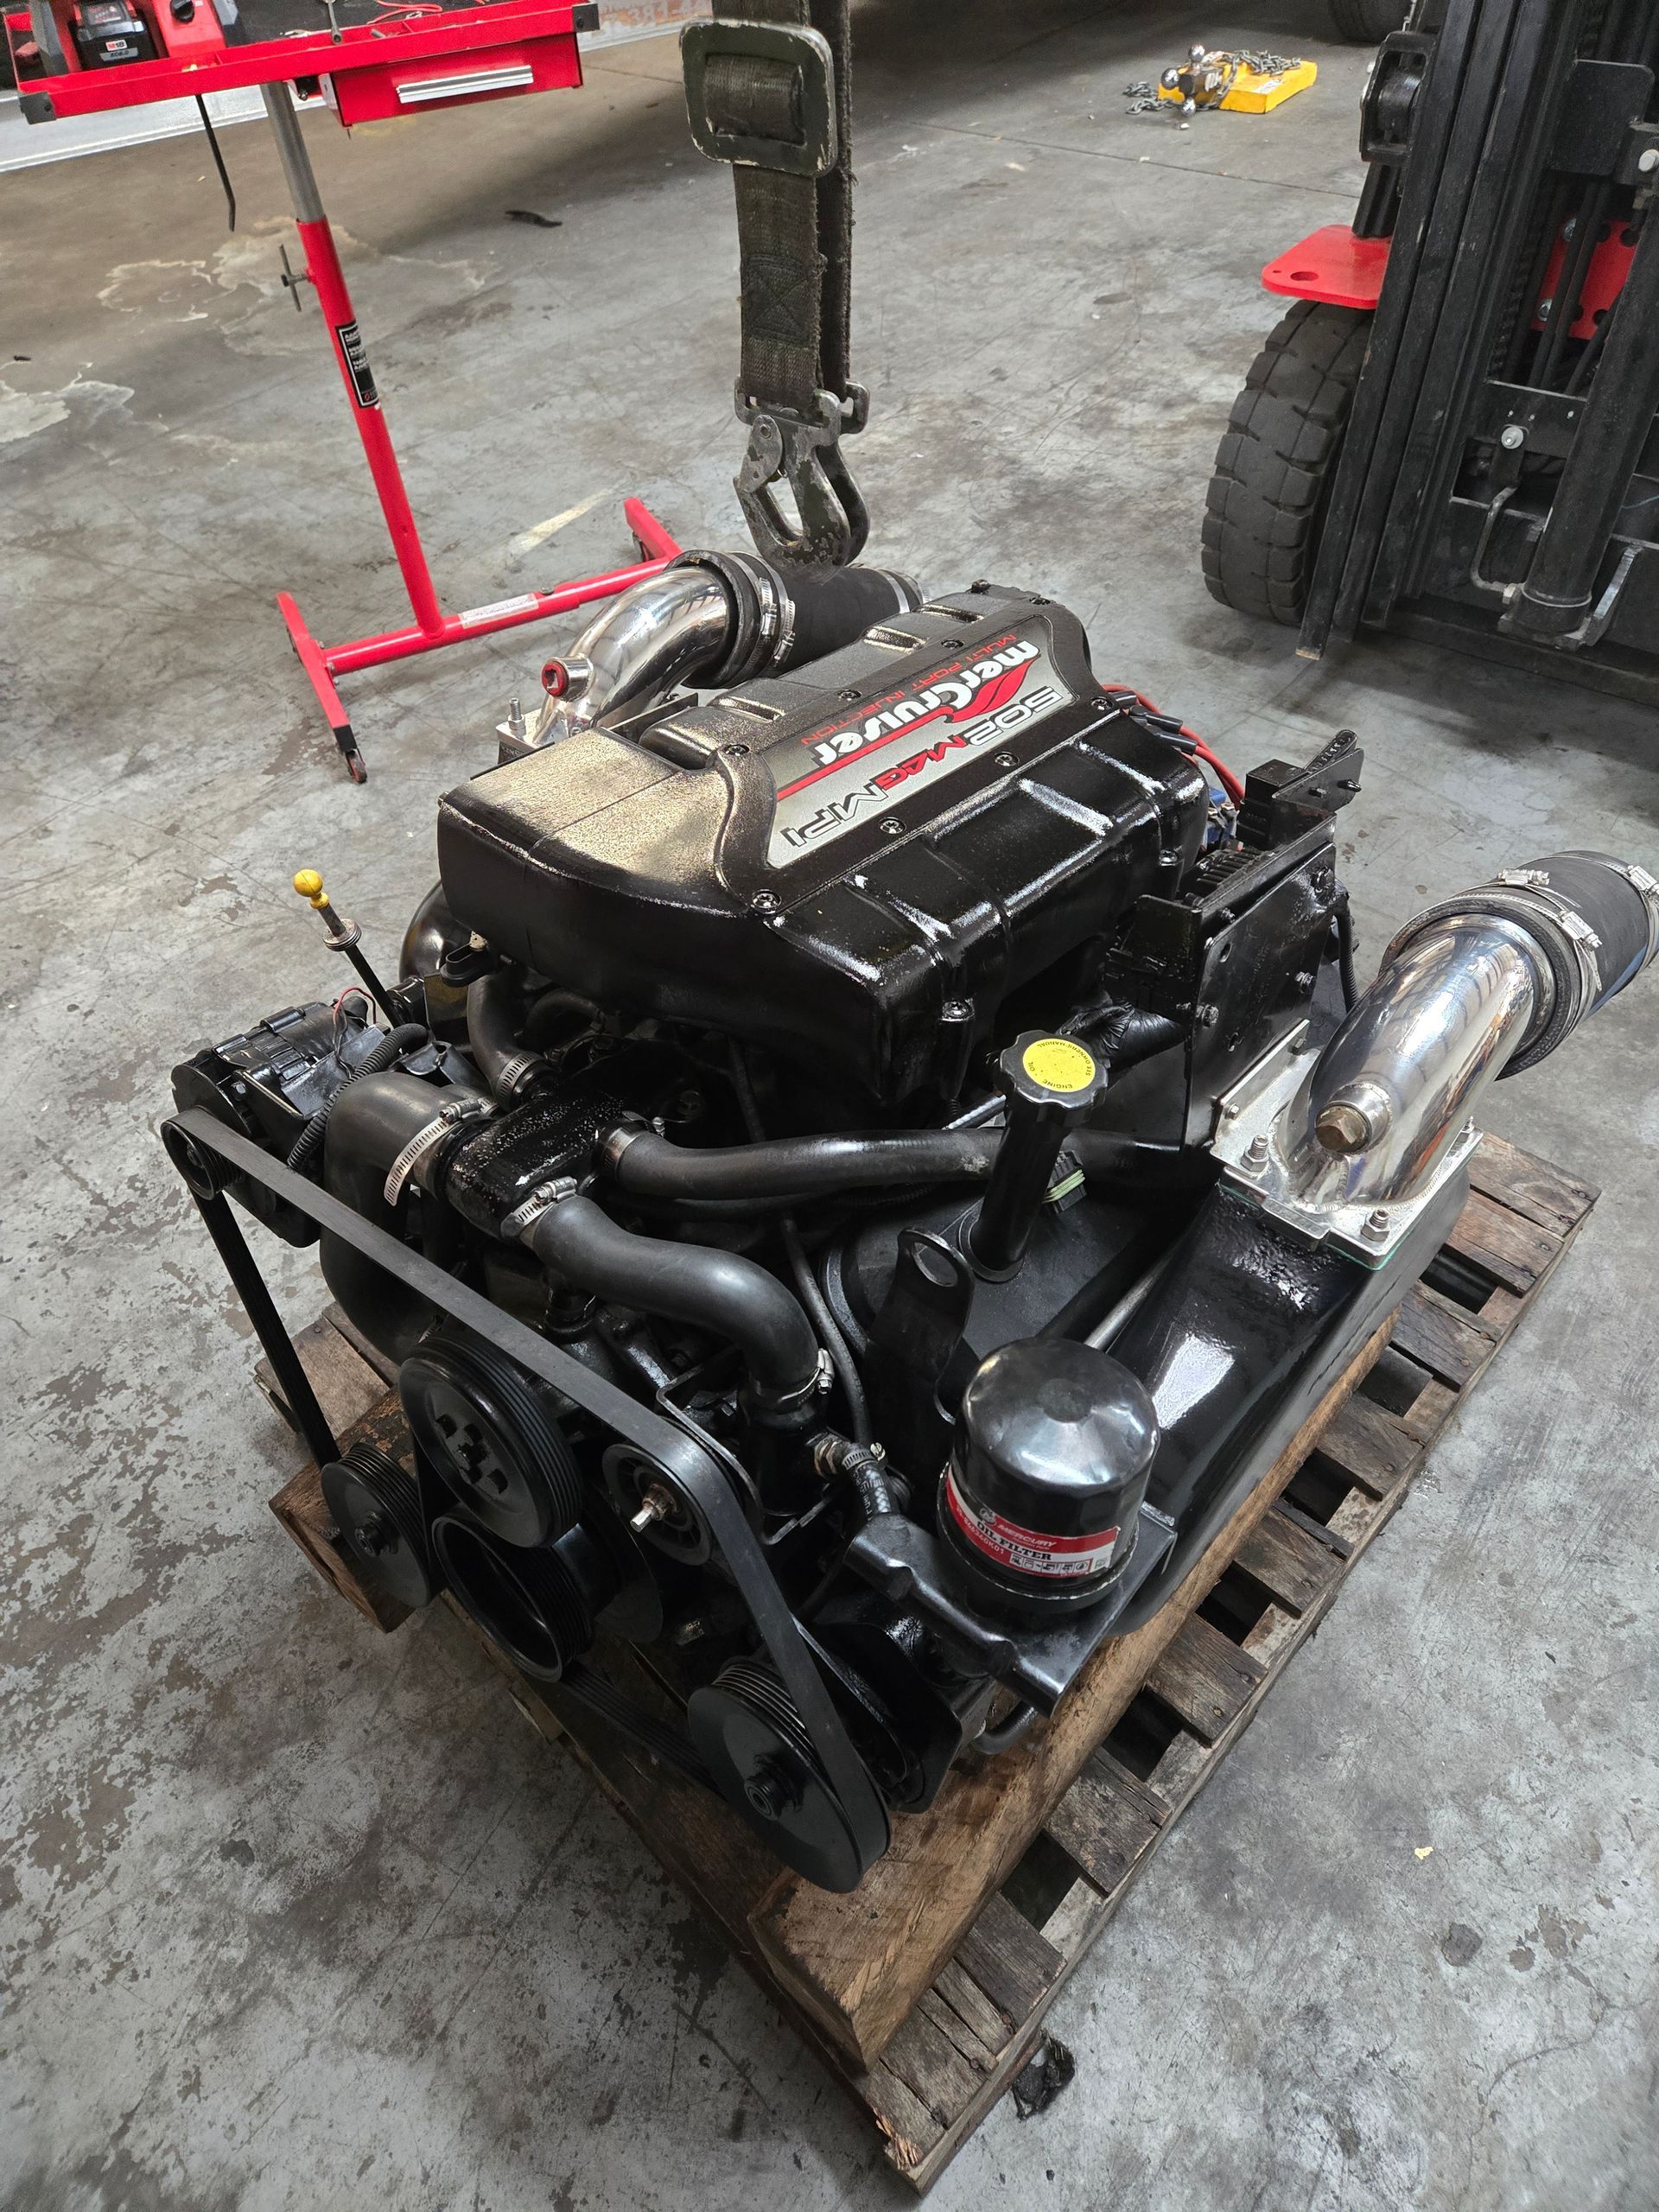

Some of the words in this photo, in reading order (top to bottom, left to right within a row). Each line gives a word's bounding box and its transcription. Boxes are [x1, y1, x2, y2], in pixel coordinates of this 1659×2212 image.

[107, 41, 125, 50] M18
[965, 634, 1017, 664] MULTI
[912, 662, 963, 690] PORT
[801, 690, 906, 746] INJECTION
[1042, 1079, 1073, 1089] ENGINE
[976, 1521, 998, 1545] OIL
[999, 1539, 1052, 1560] FILTER
[997, 1524, 1057, 1548] MERCURY
